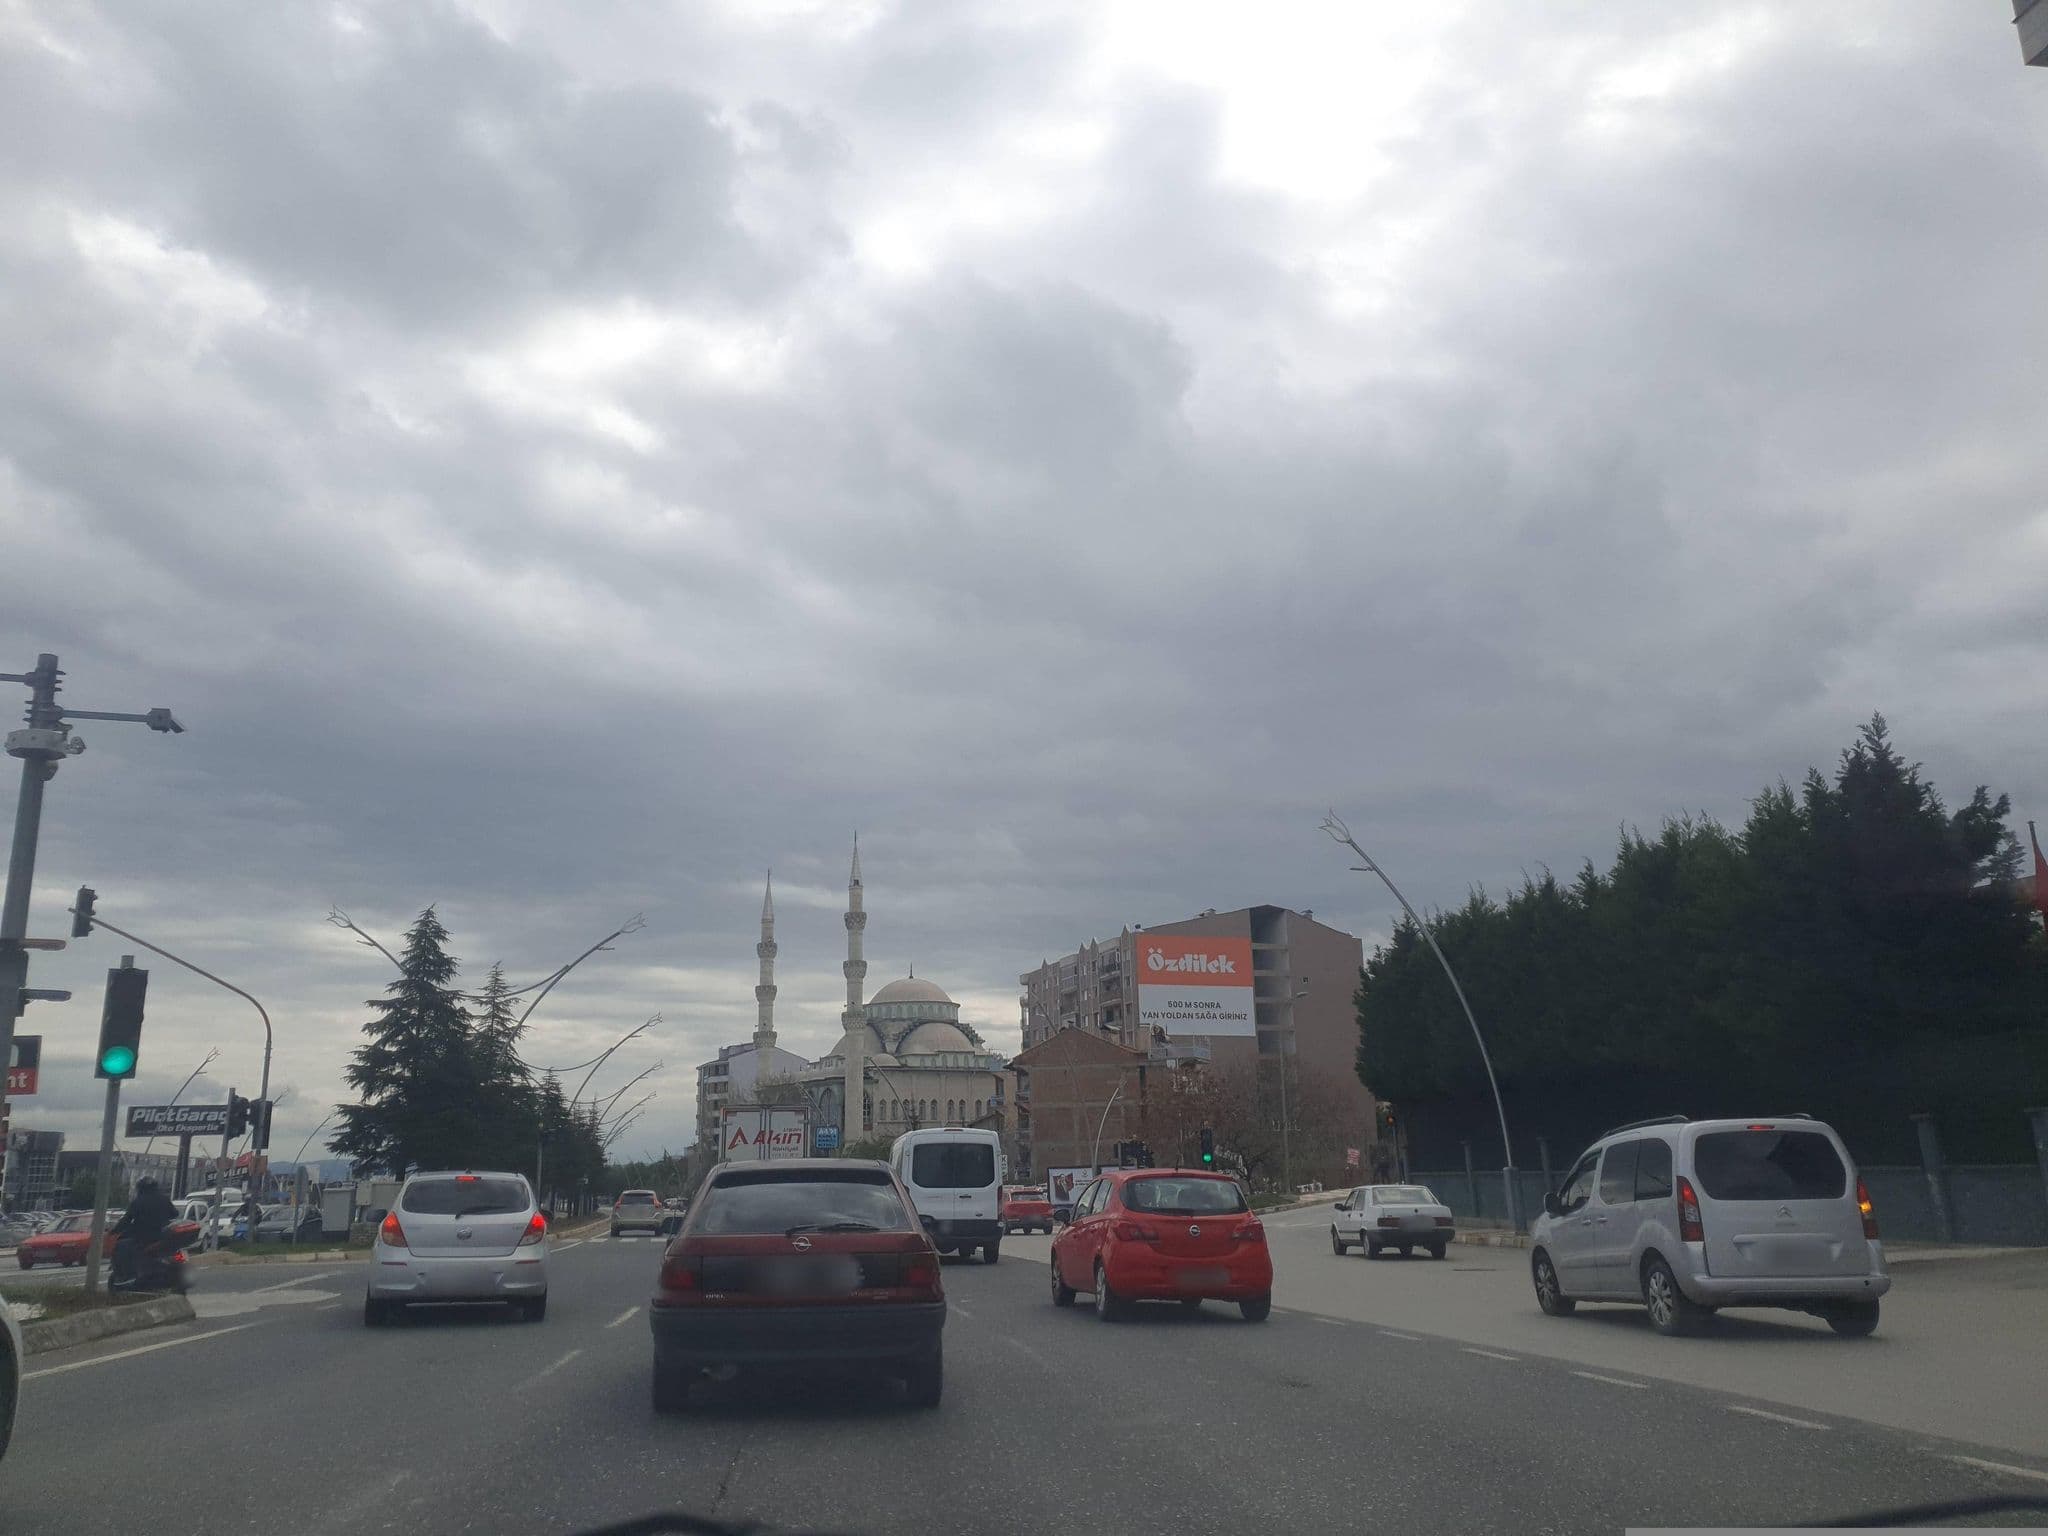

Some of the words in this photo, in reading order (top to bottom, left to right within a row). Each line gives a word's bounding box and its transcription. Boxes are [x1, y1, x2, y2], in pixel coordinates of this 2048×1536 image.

[1148, 947, 1236, 974] Özdilek
[1167, 1000, 1183, 1008] 500
[1184, 1001, 1193, 1009] M
[1193, 1001, 1221, 1009] SONRA
[1142, 1011, 1159, 1019] YAN
[1160, 1011, 1194, 1020] YOLDAN
[1194, 1010, 1219, 1020] SAĞA
[1219, 1011, 1247, 1021] GİRİNİZ
[131, 1107, 227, 1124] PilotGarag
